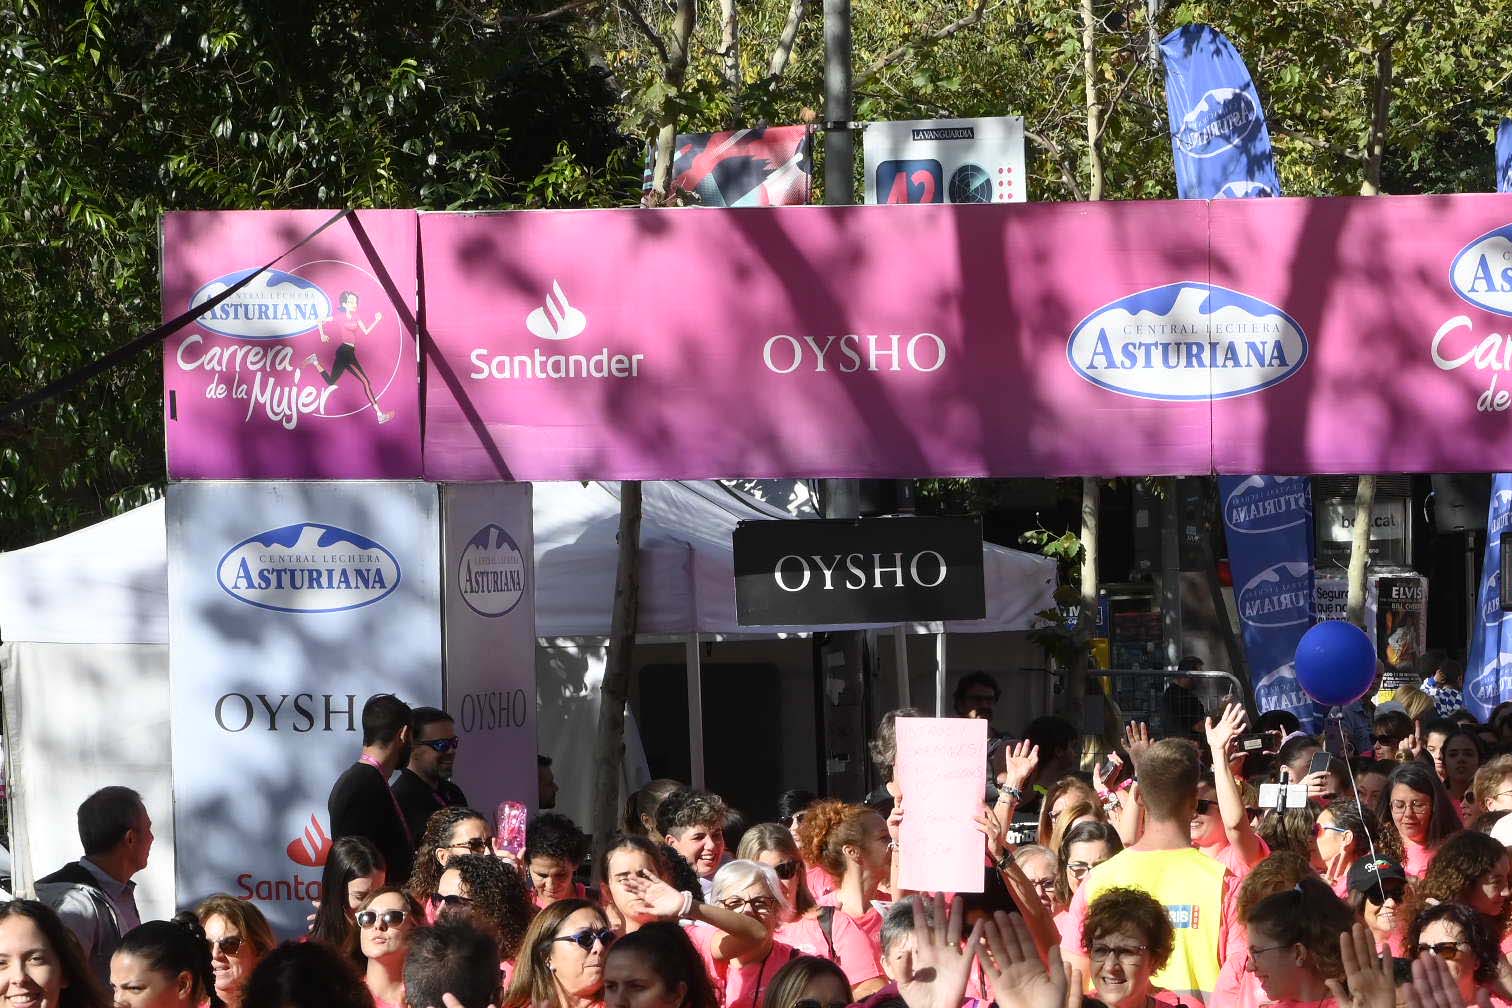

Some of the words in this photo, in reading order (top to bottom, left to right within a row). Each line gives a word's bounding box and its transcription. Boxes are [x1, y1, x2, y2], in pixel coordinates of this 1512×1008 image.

[201, 294, 319, 321] ASTURIANA
[1123, 323, 1199, 335] CENTRAL
[1206, 322, 1282, 334] LECHERA
[176, 334, 294, 371] Carrera
[470, 348, 643, 379] Santander
[763, 333, 946, 374] OYSHO
[1086, 327, 1290, 370] ASTURIANA
[205, 373, 227, 399] de
[232, 371, 248, 399] la
[245, 368, 339, 430] Mujer
[1477, 374, 1511, 412] de
[232, 556, 387, 590] ASTURIANA
[259, 555, 317, 563] CENTRAL
[323, 554, 381, 563] LECHERA
[464, 558, 522, 595] ASTURIANA
[774, 550, 947, 592] OYSHO
[1391, 586, 1422, 599] ELVIS
[214, 692, 396, 733] OYSH
[460, 689, 527, 733] OYSHO
